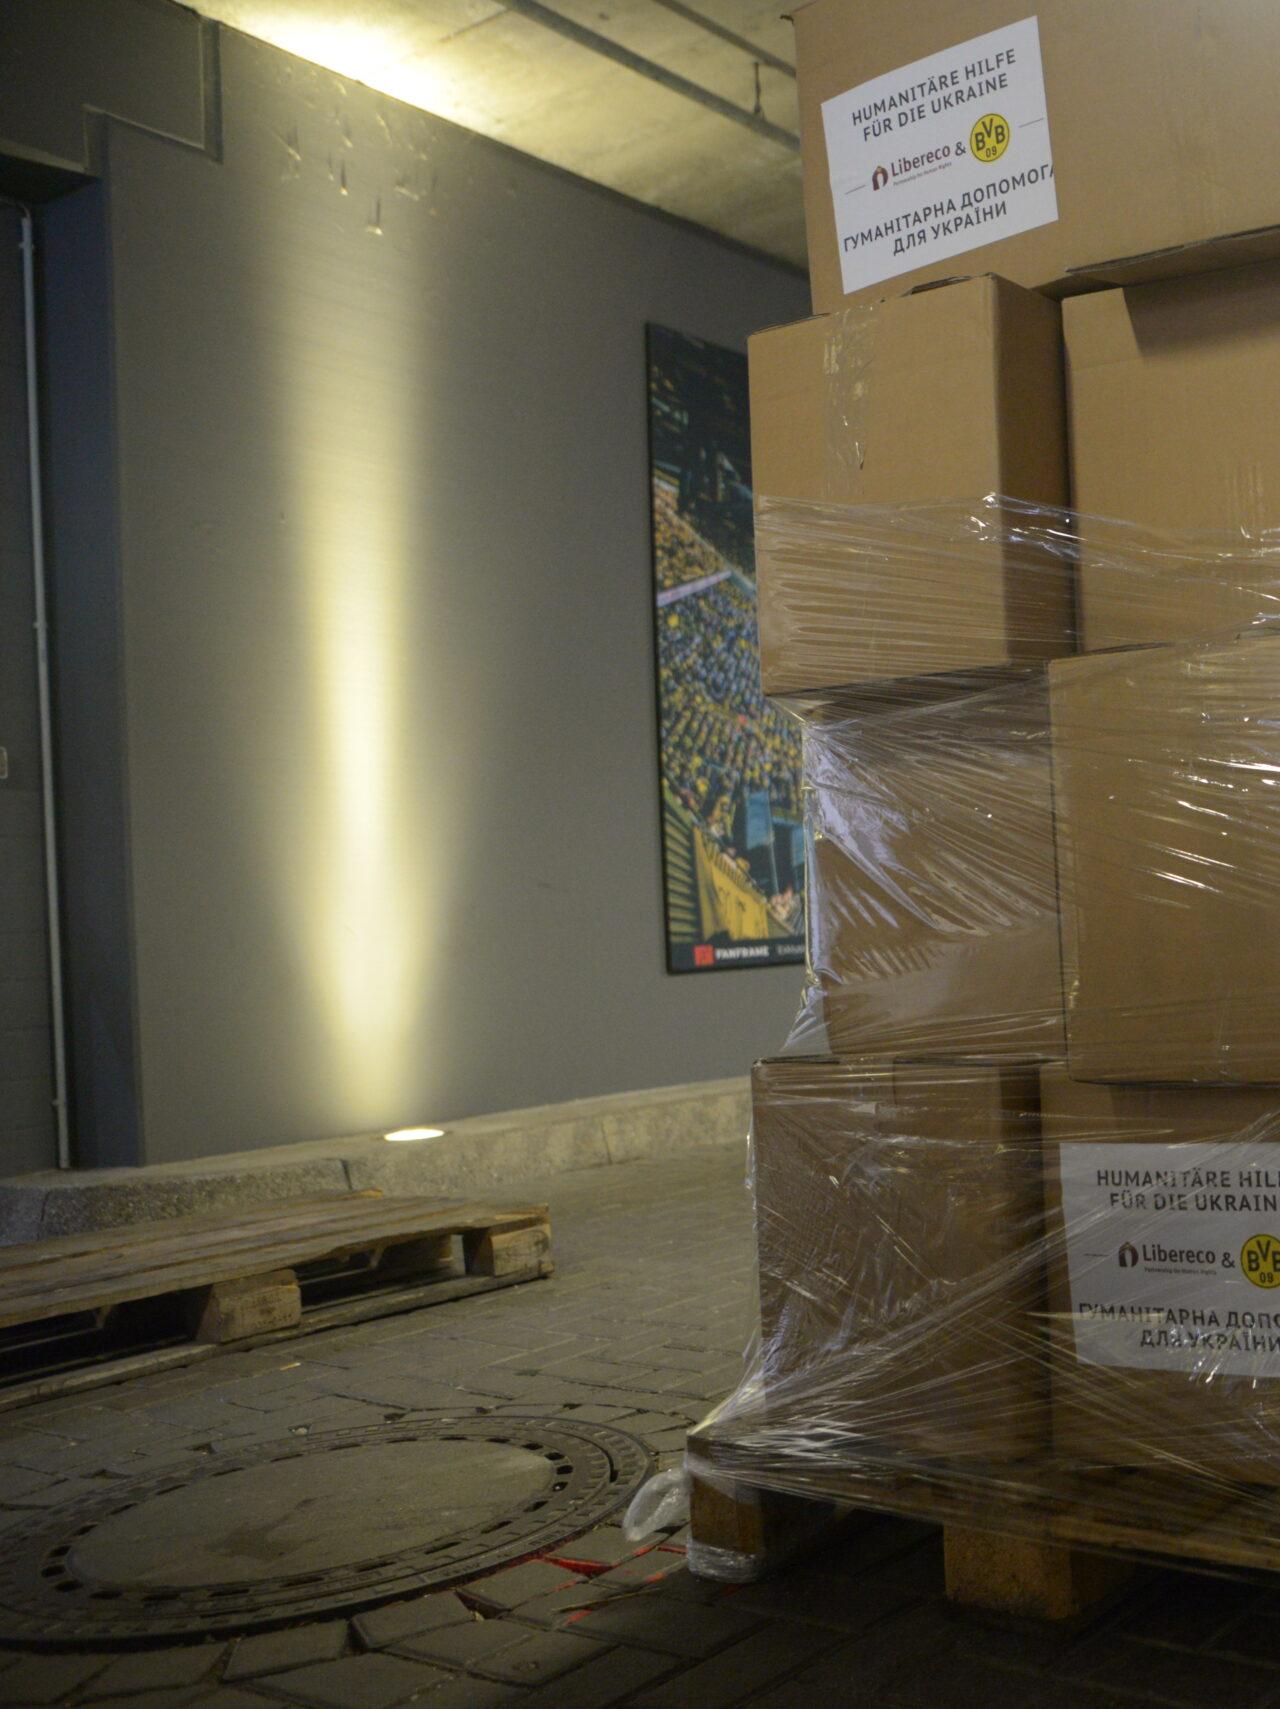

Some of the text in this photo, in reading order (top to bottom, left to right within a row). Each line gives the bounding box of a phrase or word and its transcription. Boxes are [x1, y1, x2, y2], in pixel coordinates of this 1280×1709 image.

[852, 49, 1017, 126] HUMANITÄRE HILFE
[863, 73, 1009, 142] FÜR DIE UKRAINE
[974, 118, 1006, 152] BVB
[890, 141, 967, 177] Libereco &
[985, 146, 997, 158] 09
[843, 198, 956, 252] ГУМАНІТАРНА
[893, 201, 1008, 256] ДЛЯ УКРАЇНИ
[1097, 1168, 1231, 1188] HUMANITÄRE
[1109, 1190, 1148, 1210] FÜR
[1153, 1194, 1188, 1211] DIE
[1142, 1244, 1235, 1268] Libereco &
[1259, 1271, 1274, 1284] 09
[1078, 1302, 1221, 1328] ГУМАНІТАРНА
